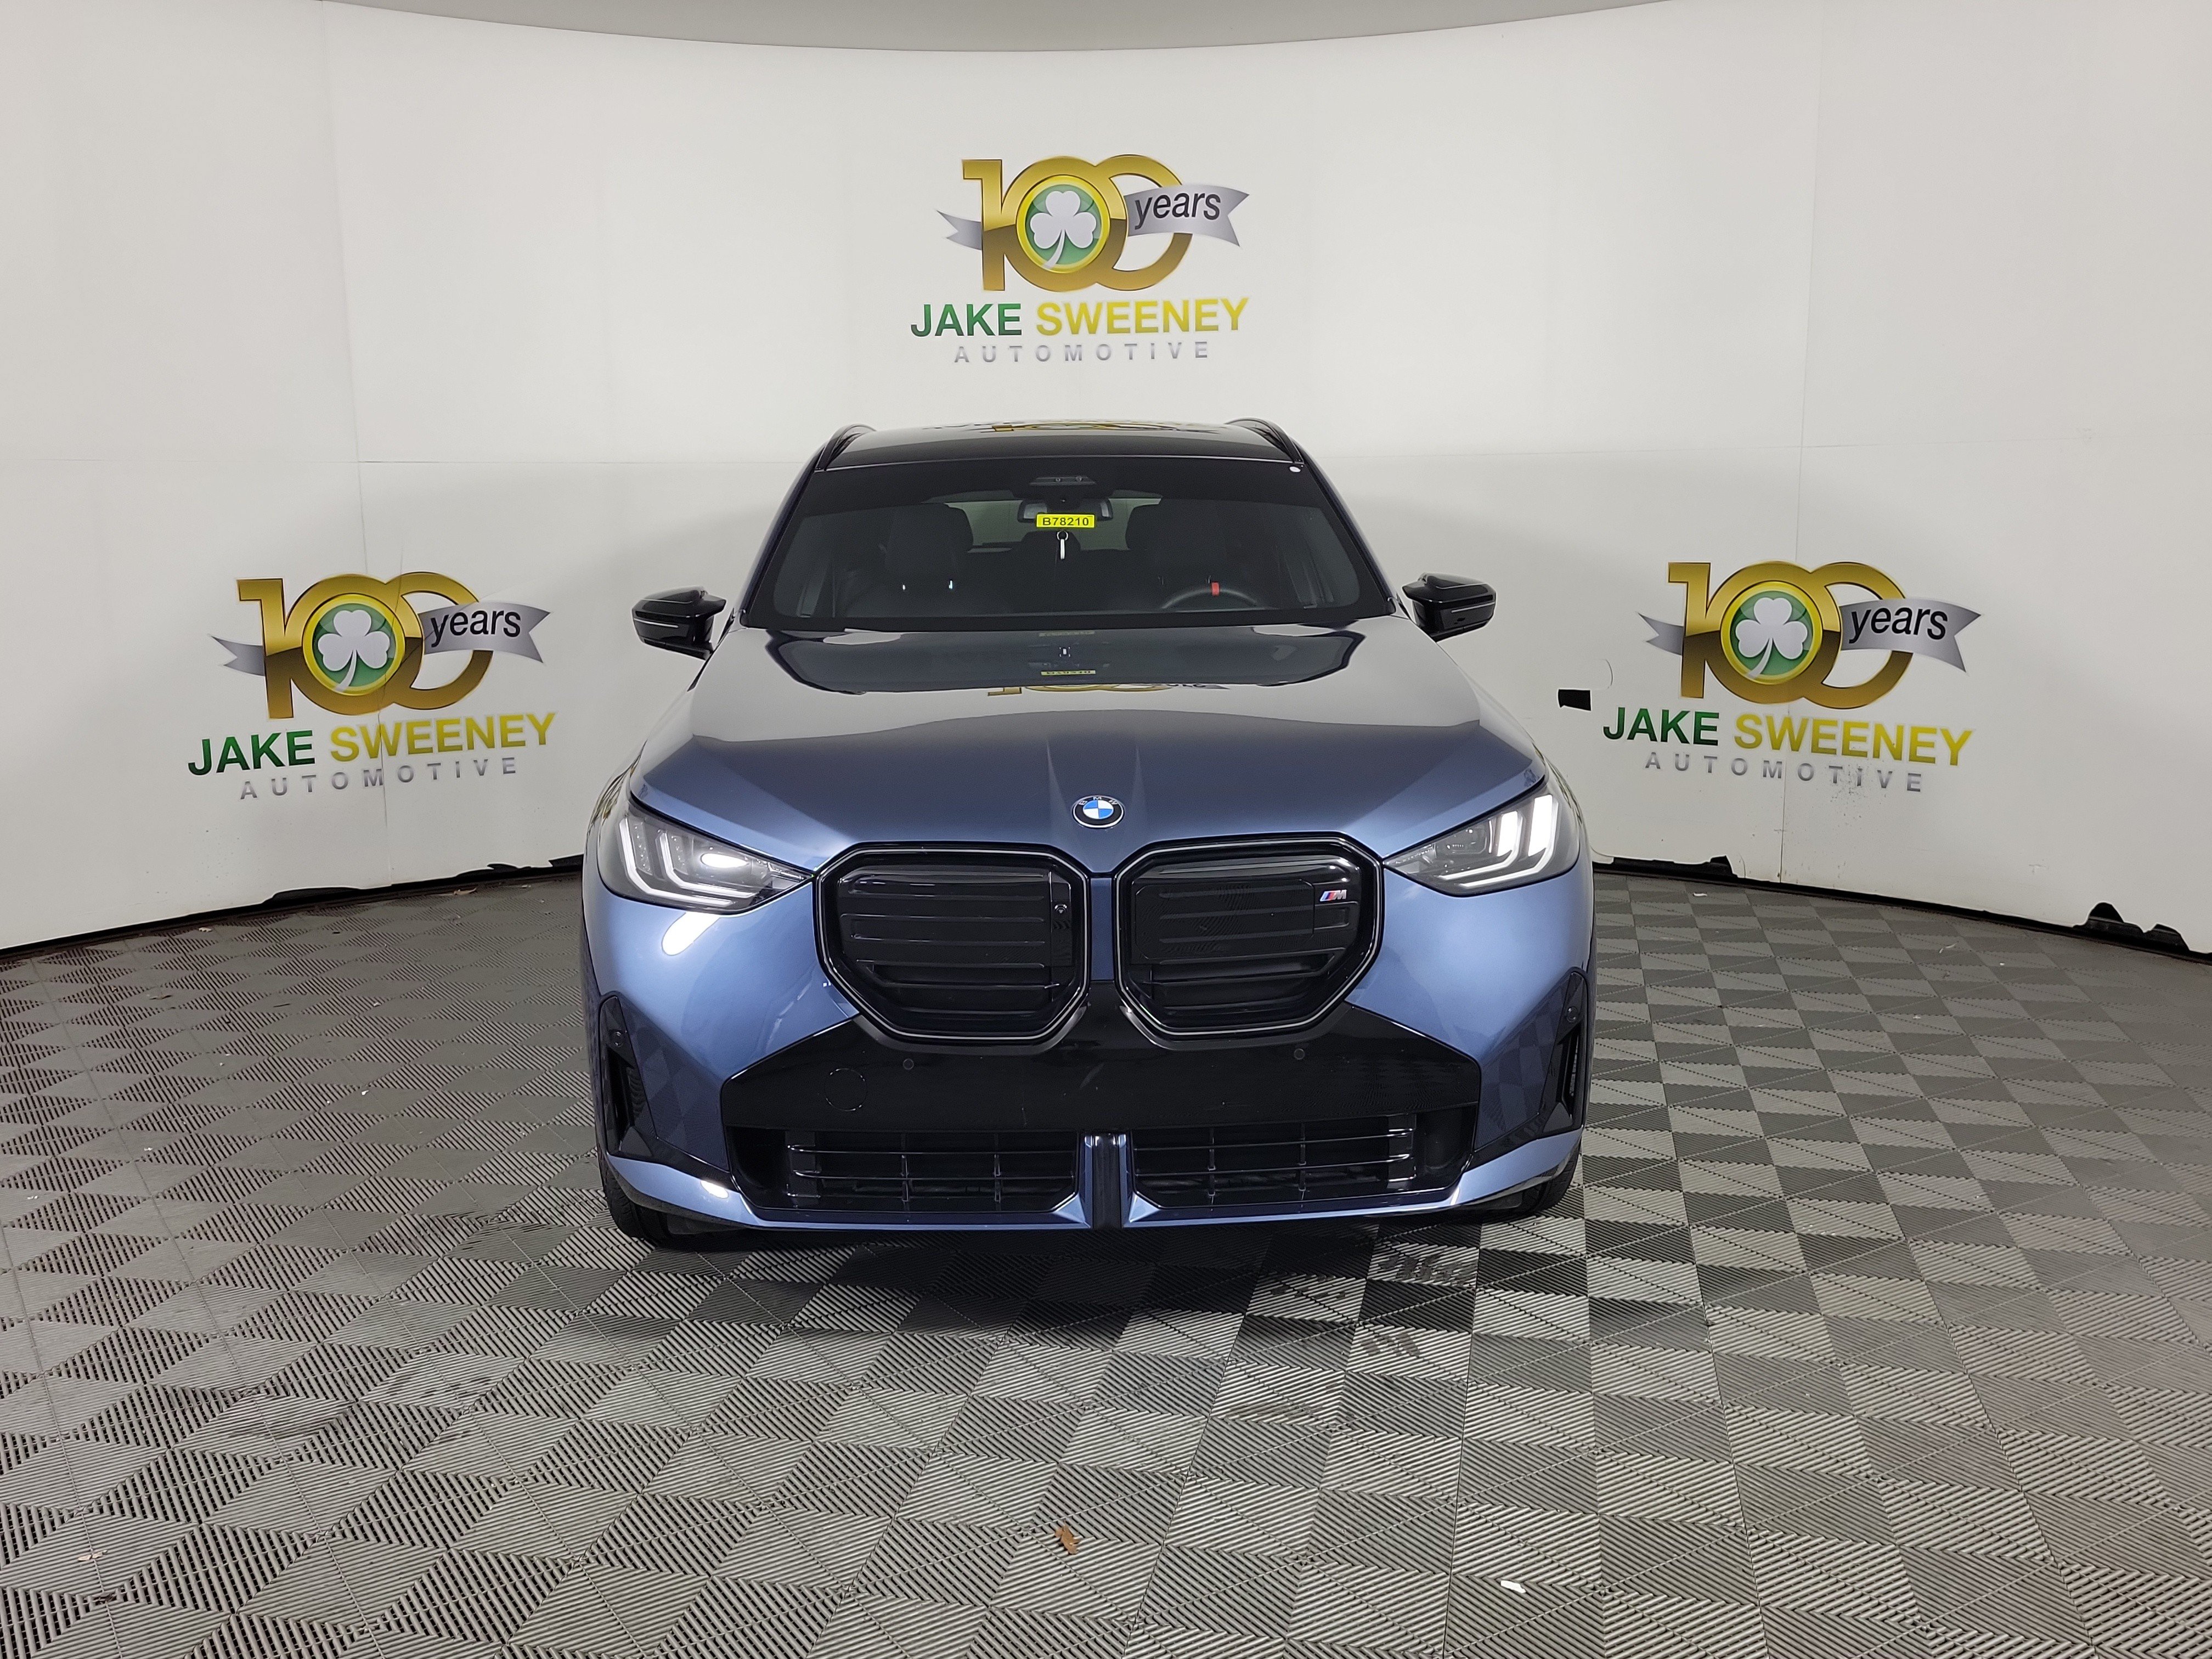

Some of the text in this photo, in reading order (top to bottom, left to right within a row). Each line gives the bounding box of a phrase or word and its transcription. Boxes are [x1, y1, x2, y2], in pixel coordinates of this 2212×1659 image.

[962, 154, 1222, 292] 100 years
[911, 297, 1250, 337] JAKE SWEENEY
[954, 341, 1209, 364] AUTOMOTIVE
[1042, 517, 1089, 526] B78210
[236, 572, 521, 719] 100 years
[1668, 561, 1948, 709] 100 years
[188, 712, 556, 776] JAKE SWEENEY
[1603, 707, 1973, 766] JAKE SWEENEY
[240, 757, 517, 800] AUTOMOTIVE
[1645, 751, 1922, 793] AUTOMOTIVE
[1078, 796, 1119, 805] BMW
